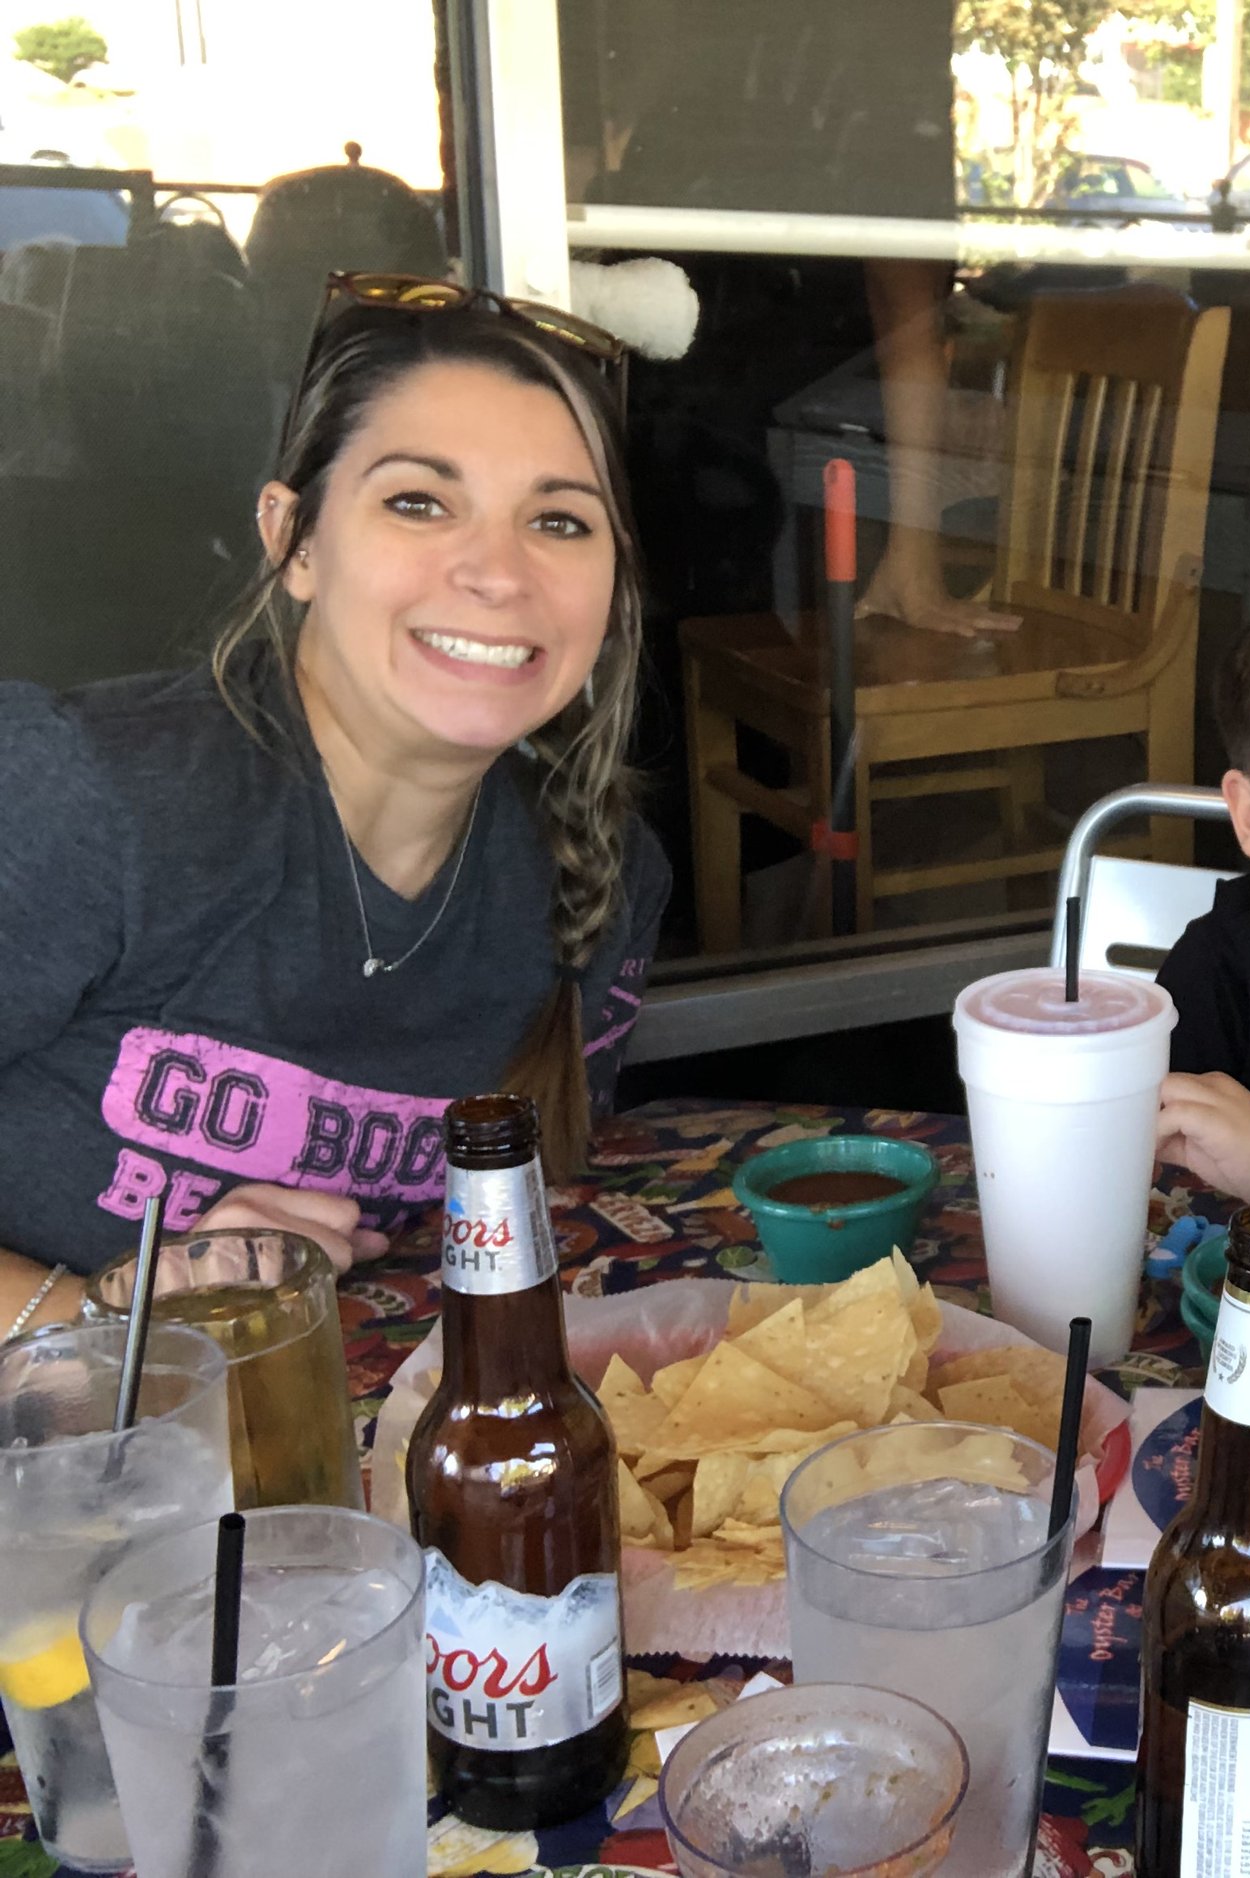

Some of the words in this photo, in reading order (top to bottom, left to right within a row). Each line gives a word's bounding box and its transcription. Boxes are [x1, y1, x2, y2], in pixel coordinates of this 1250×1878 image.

[134, 1048, 269, 1153] GO
[291, 1097, 447, 1185] BOO
[442, 1214, 514, 1247] oors
[446, 1244, 500, 1271] GHT
[1064, 1597, 1089, 1616] The
[1097, 1573, 1139, 1601] Bar
[1089, 1602, 1128, 1661] Oyster
[426, 1633, 558, 1698] oors
[431, 1687, 535, 1738] GHT
